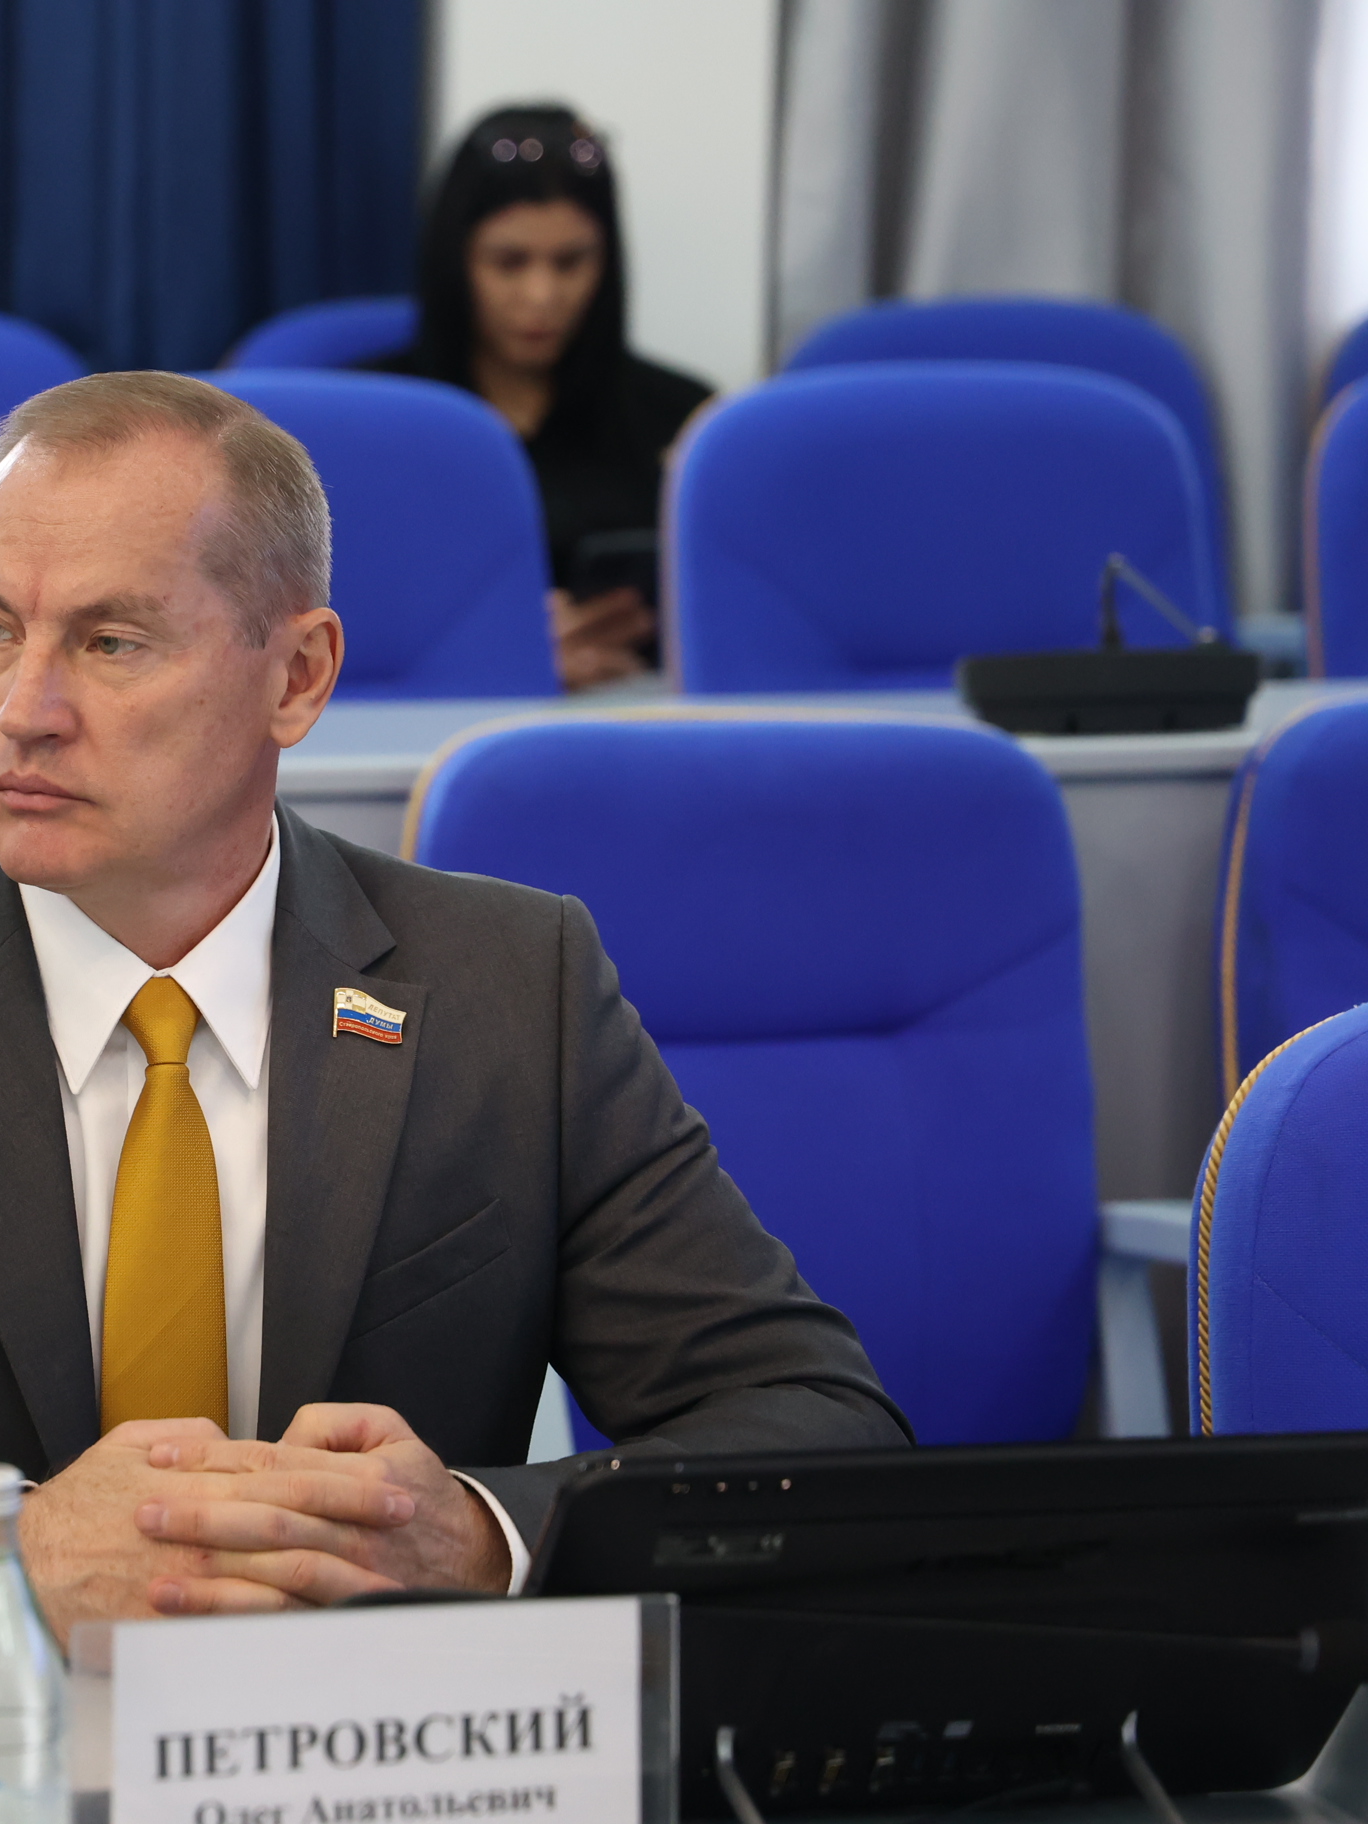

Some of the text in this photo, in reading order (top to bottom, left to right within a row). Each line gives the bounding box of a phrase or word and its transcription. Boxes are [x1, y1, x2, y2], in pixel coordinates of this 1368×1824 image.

[368, 1004, 401, 1020] ДЕПУТАТ
[368, 1017, 394, 1030] ДУМЫ
[152, 1693, 595, 1781] ПЕТРОВСКИЙ
[194, 1784, 557, 1824] Олег Анатольевич
